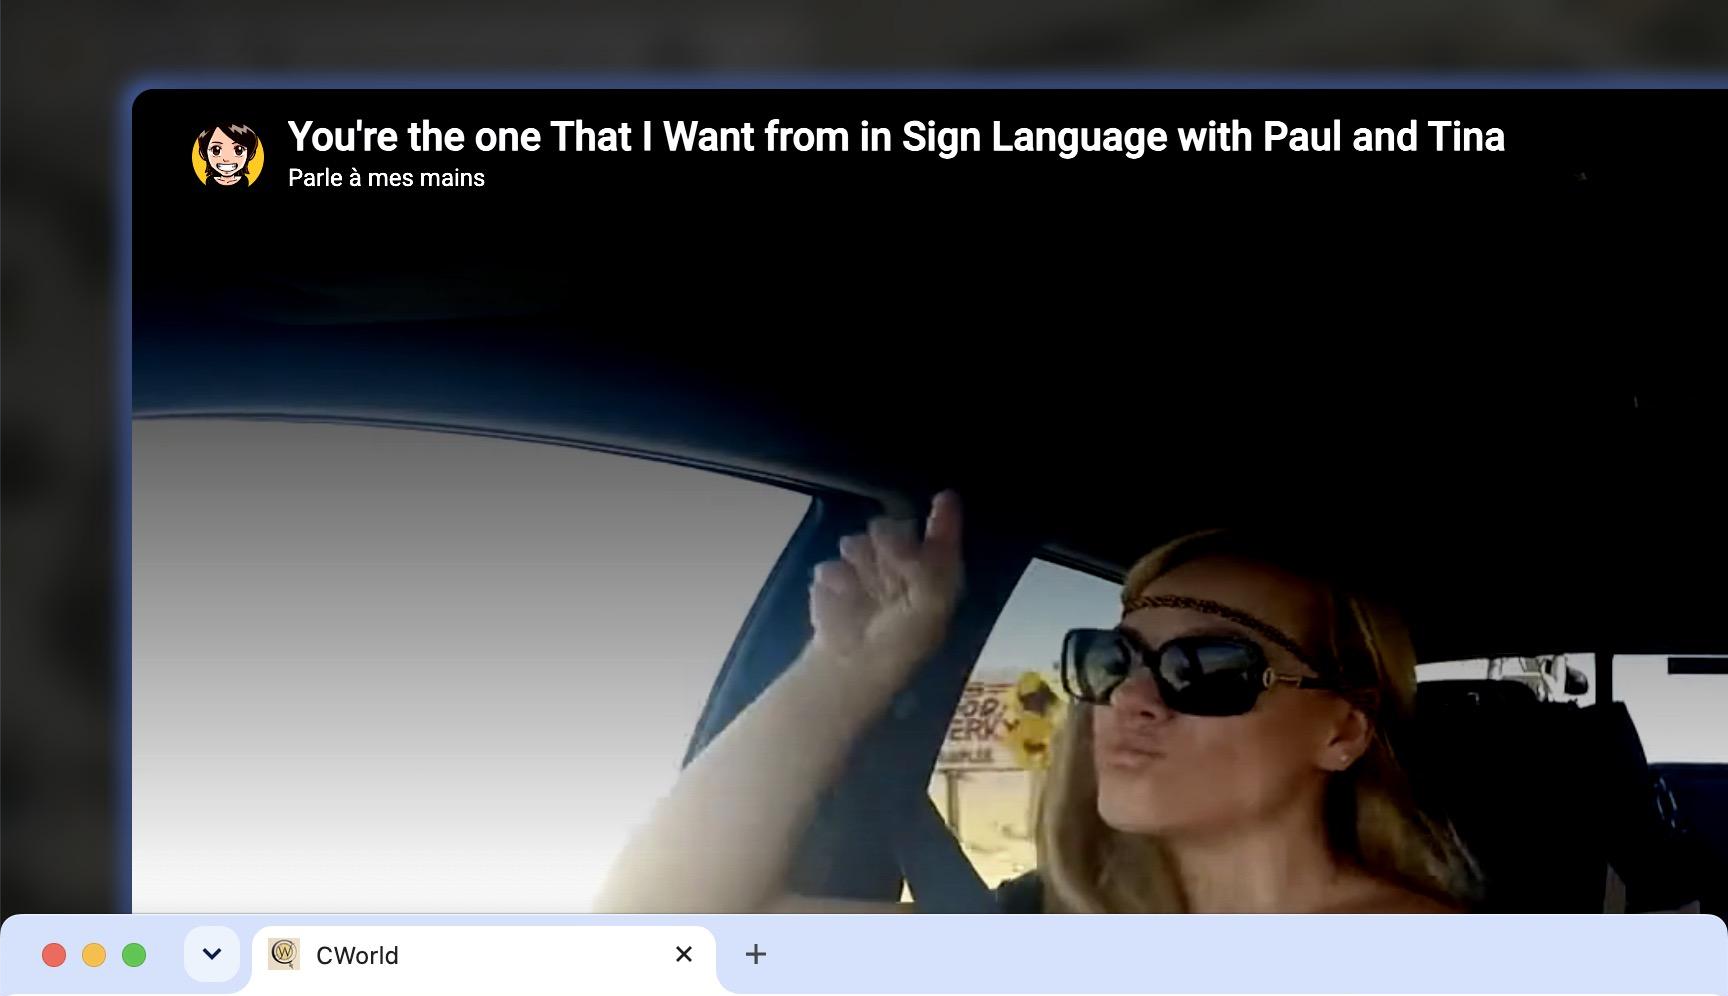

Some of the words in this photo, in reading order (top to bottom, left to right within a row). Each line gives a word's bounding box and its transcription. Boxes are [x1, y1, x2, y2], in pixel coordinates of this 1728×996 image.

[288, 118, 398, 152] You're
[407, 118, 465, 152] the
[475, 127, 542, 152] one
[549, 118, 633, 152] That
[643, 120, 652, 152] I
[662, 120, 755, 152] Want
[764, 118, 849, 152] from
[860, 119, 892, 152] in
[902, 119, 981, 160] Sign
[993, 119, 1168, 160] Language
[1177, 118, 1252, 152] with
[1264, 118, 1341, 152] Paul
[1352, 119, 1418, 152] and
[1427, 119, 1506, 152] Tina
[289, 166, 343, 187] Parle
[349, 166, 362, 187] à
[368, 172, 414, 187] mes
[420, 167, 486, 187] mains
[316, 945, 399, 966] CWorld
